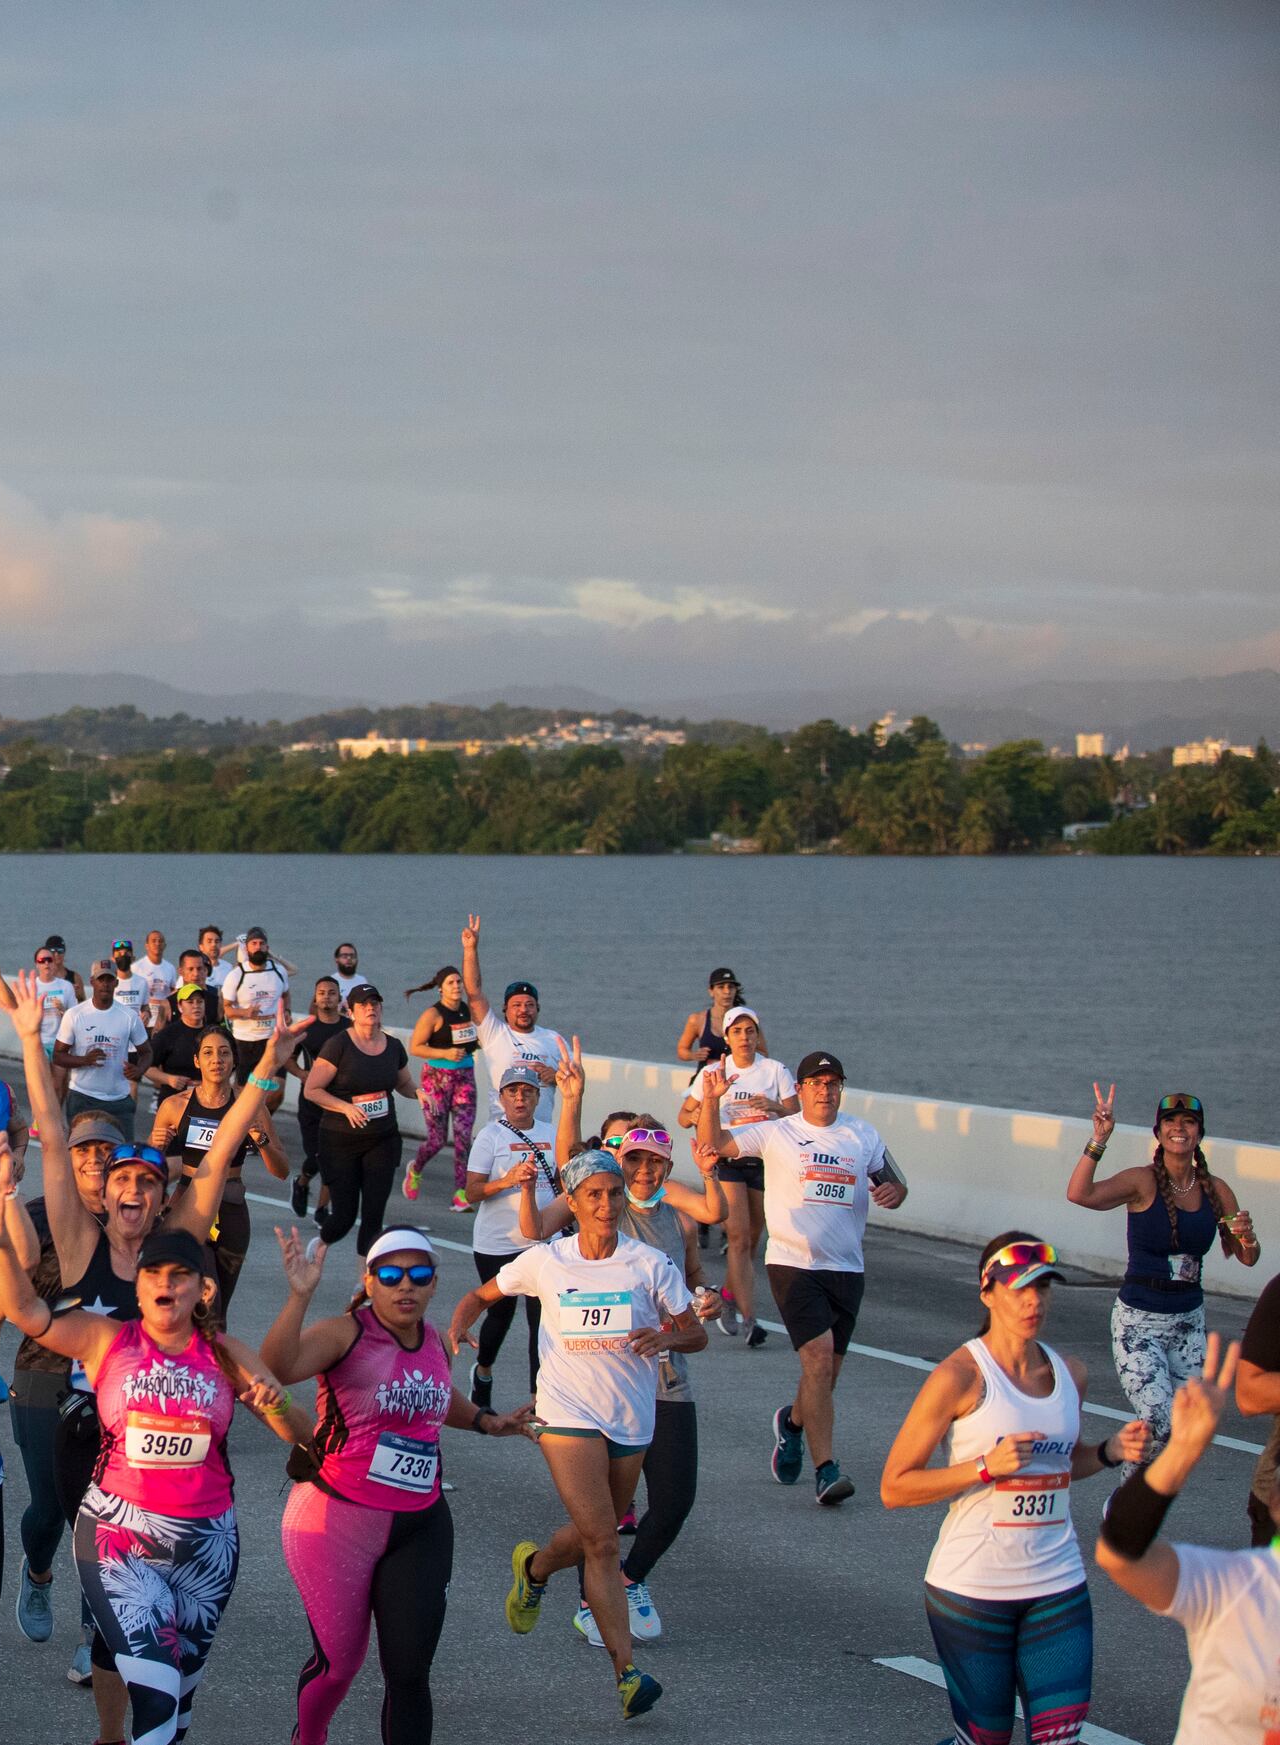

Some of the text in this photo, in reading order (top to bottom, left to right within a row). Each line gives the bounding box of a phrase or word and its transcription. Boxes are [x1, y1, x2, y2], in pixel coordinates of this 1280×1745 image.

[521, 1052, 540, 1061] 10K
[812, 1152, 841, 1165] 10K
[815, 1183, 846, 1199] 3058
[581, 1308, 611, 1327] 797
[131, 1375, 202, 1398] MASOQUISTAS
[141, 1433, 193, 1457] 3950
[390, 1453, 433, 1480] 7336
[1012, 1493, 1056, 1517] 3331
